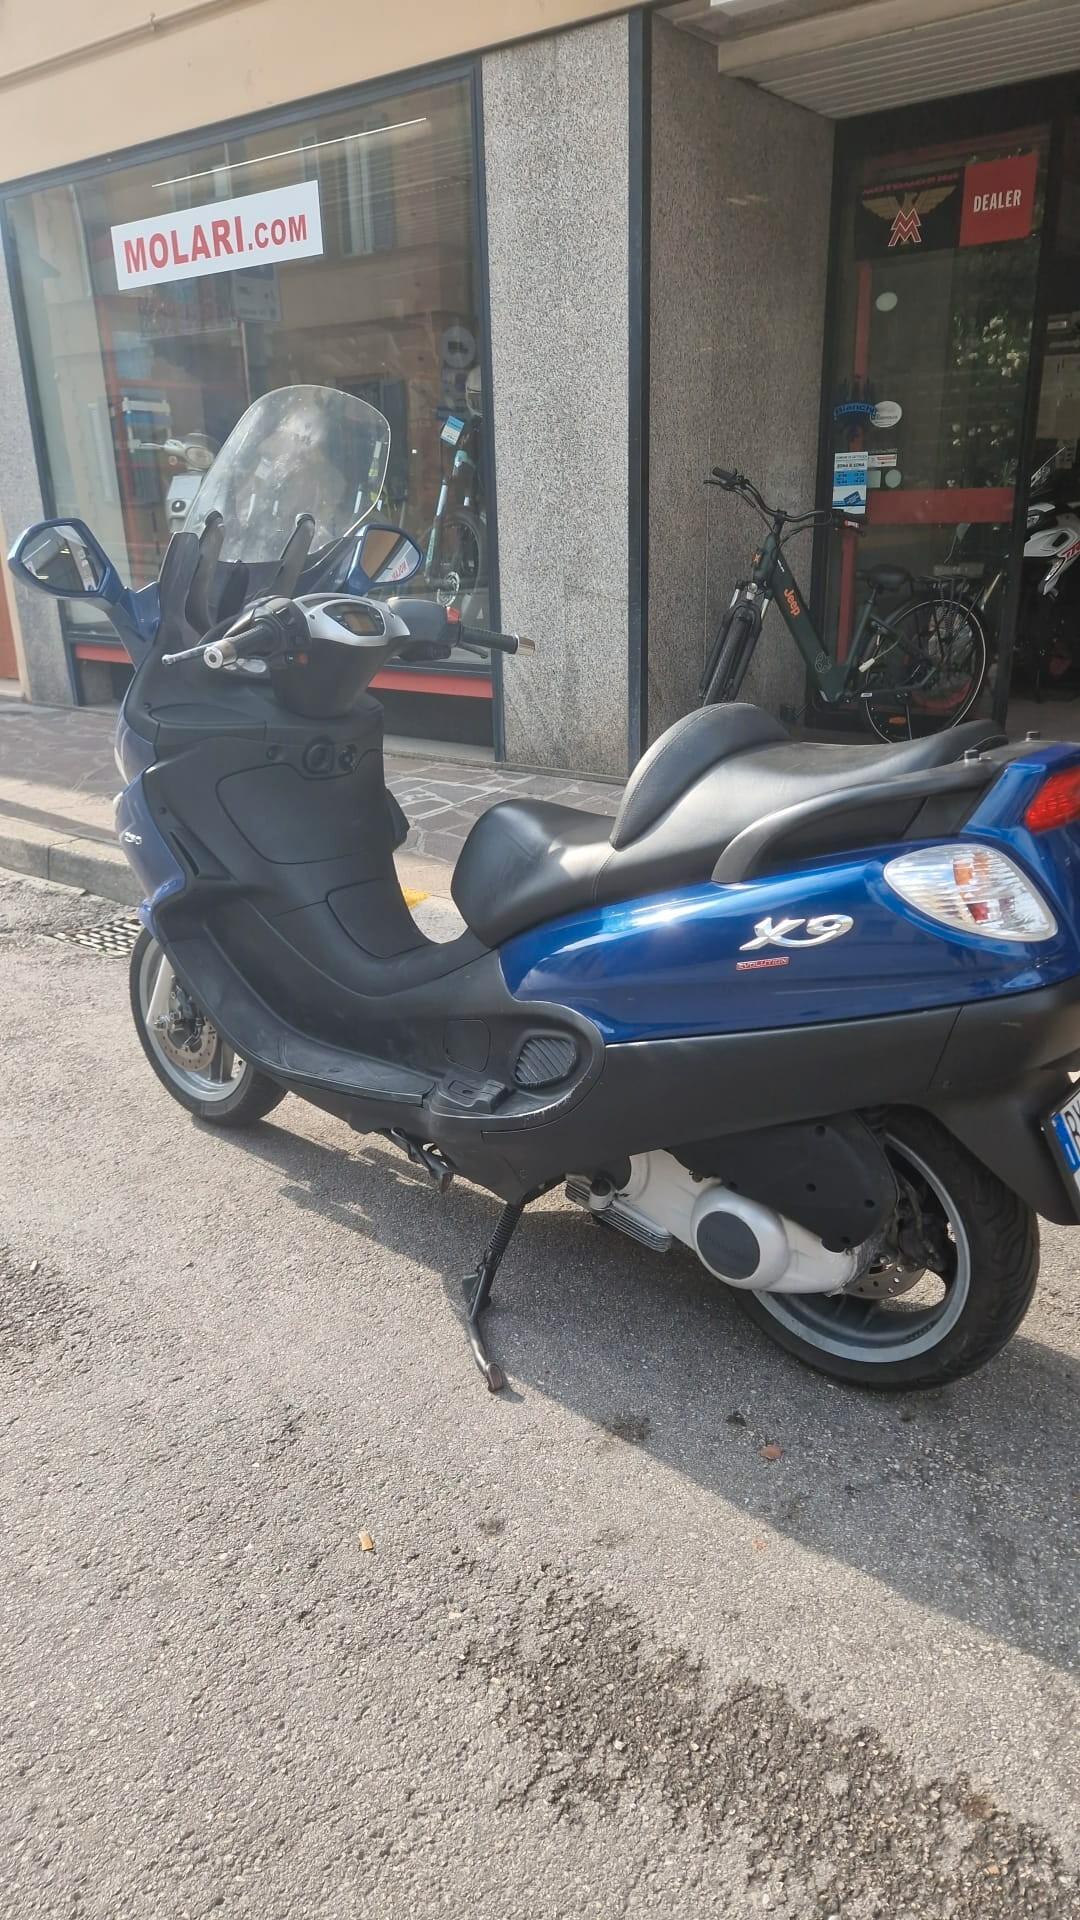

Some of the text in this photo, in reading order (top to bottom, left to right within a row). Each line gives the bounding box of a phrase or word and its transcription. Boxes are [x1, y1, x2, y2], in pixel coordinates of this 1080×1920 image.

[973, 189, 1022, 213] DEALER
[124, 214, 308, 274] MOLARI.COM
[784, 588, 801, 616] Jeep
[739, 914, 854, 951] X9
